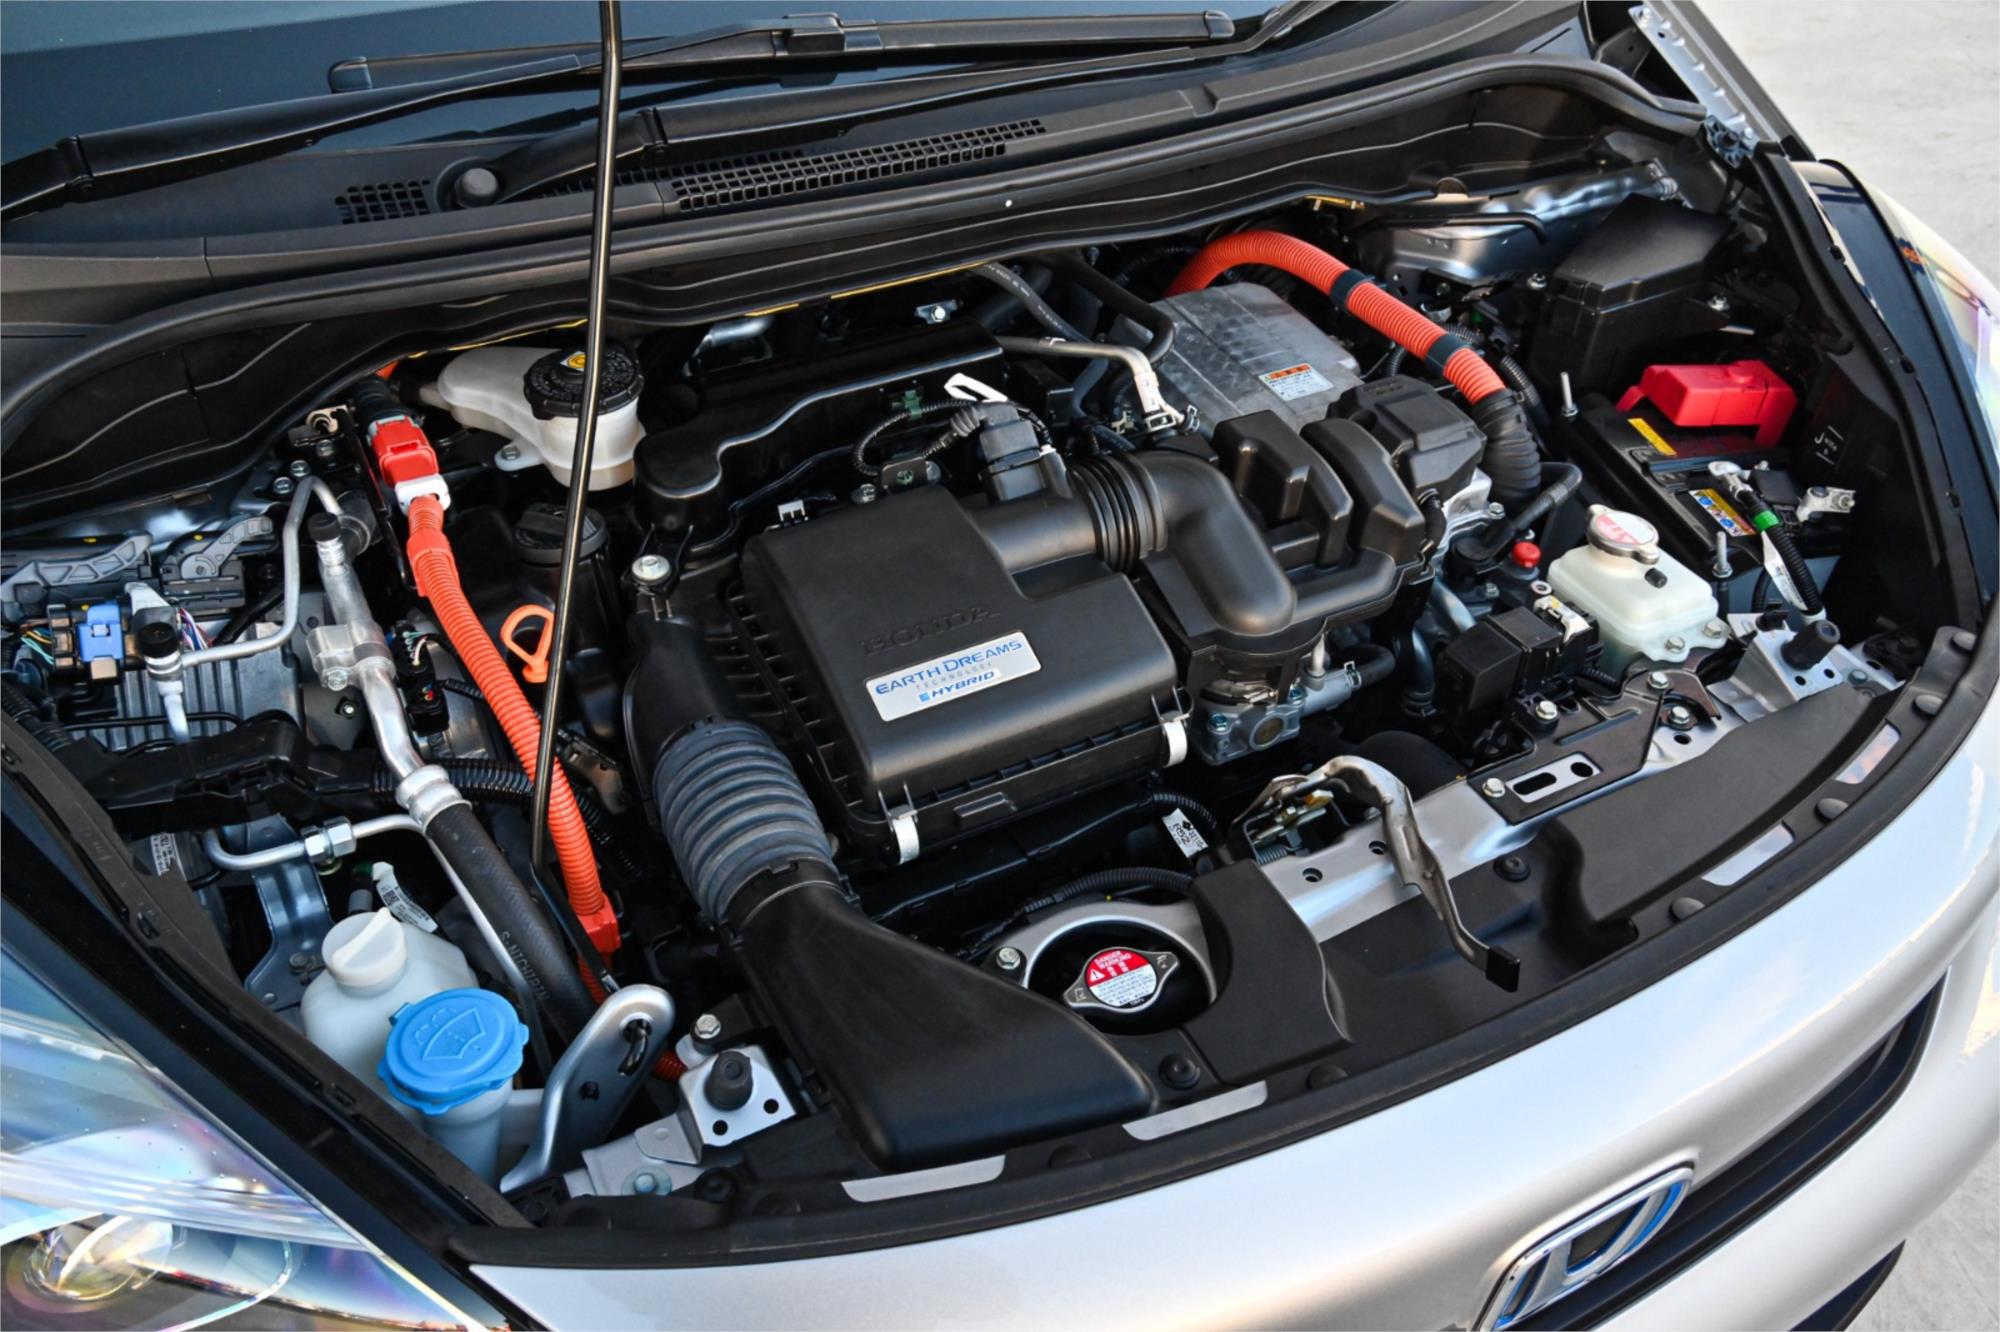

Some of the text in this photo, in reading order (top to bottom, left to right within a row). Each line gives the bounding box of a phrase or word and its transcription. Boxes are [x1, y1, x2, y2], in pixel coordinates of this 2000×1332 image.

[861, 606, 1000, 655] HONDA
[875, 641, 1022, 695] EARTH DREAMS
[917, 662, 992, 691] TECHNOLOGY
[932, 671, 994, 698] HYBRID
